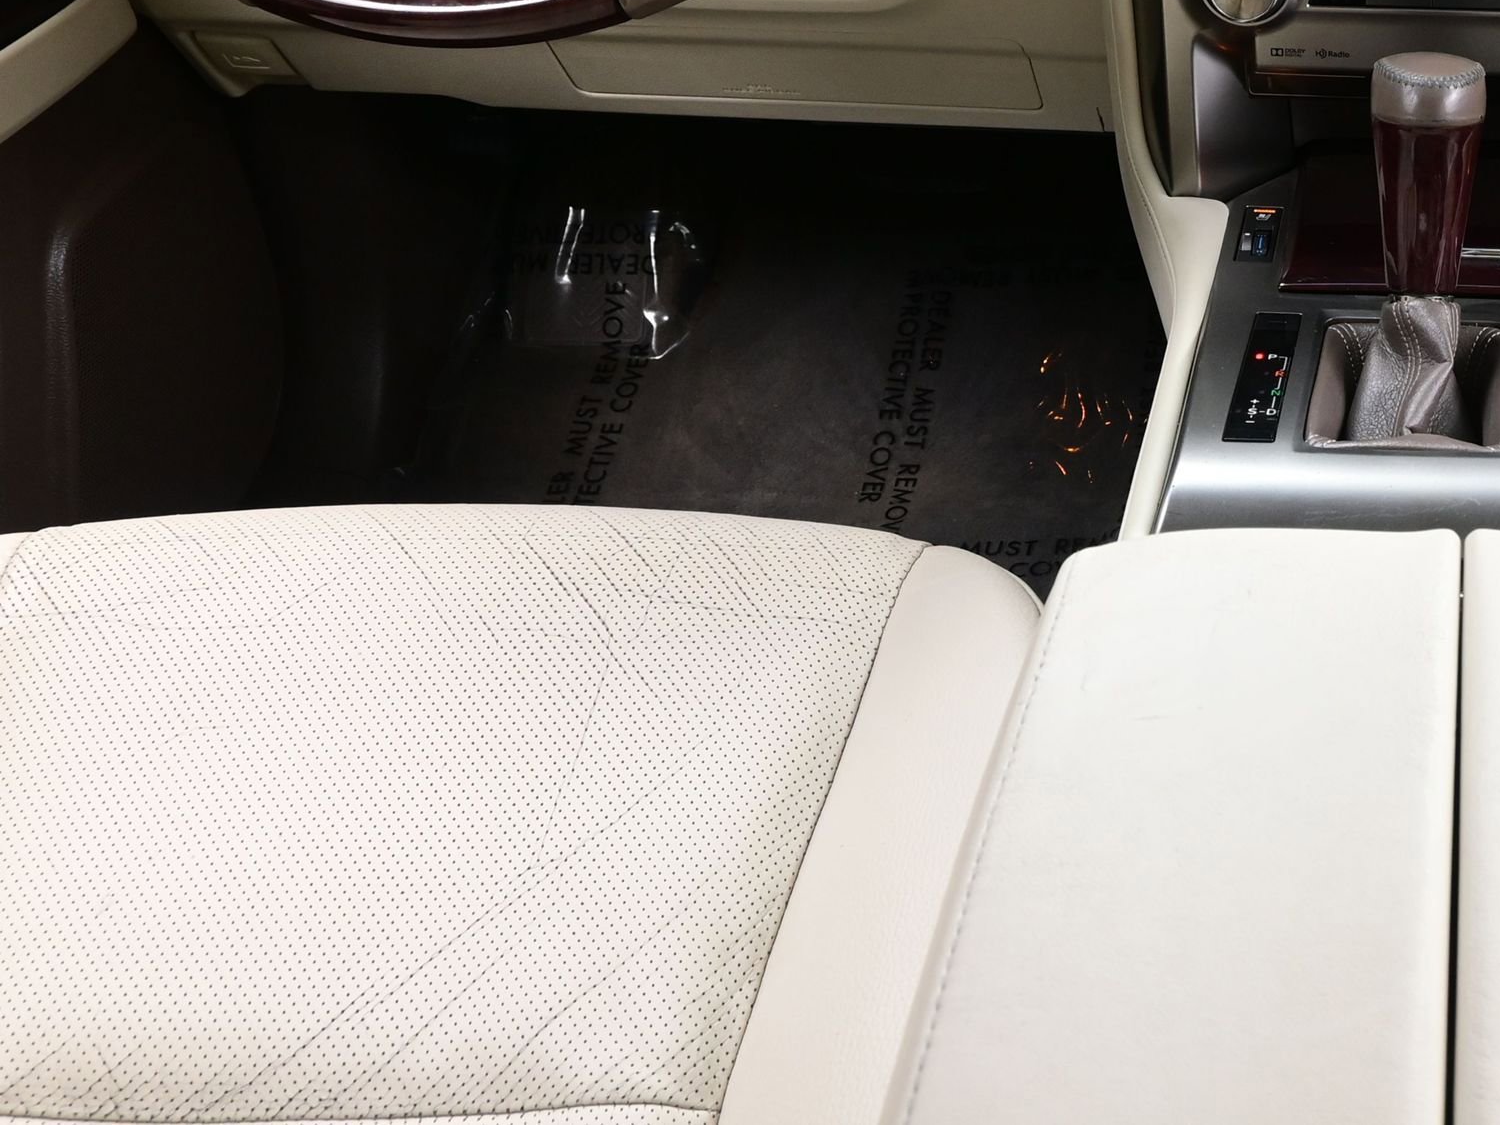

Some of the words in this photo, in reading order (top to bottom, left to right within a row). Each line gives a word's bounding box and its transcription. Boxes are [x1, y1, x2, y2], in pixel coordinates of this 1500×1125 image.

[879, 292, 923, 422] PROTECTIVE
[918, 290, 952, 372] DEALER
[562, 394, 604, 456] MUST
[589, 281, 628, 385] REMOVE
[608, 343, 651, 414] COVER
[903, 386, 936, 451] MUST
[1266, 408, 1277, 416] D
[857, 430, 897, 504] COVER
[880, 462, 921, 534] REMOV
